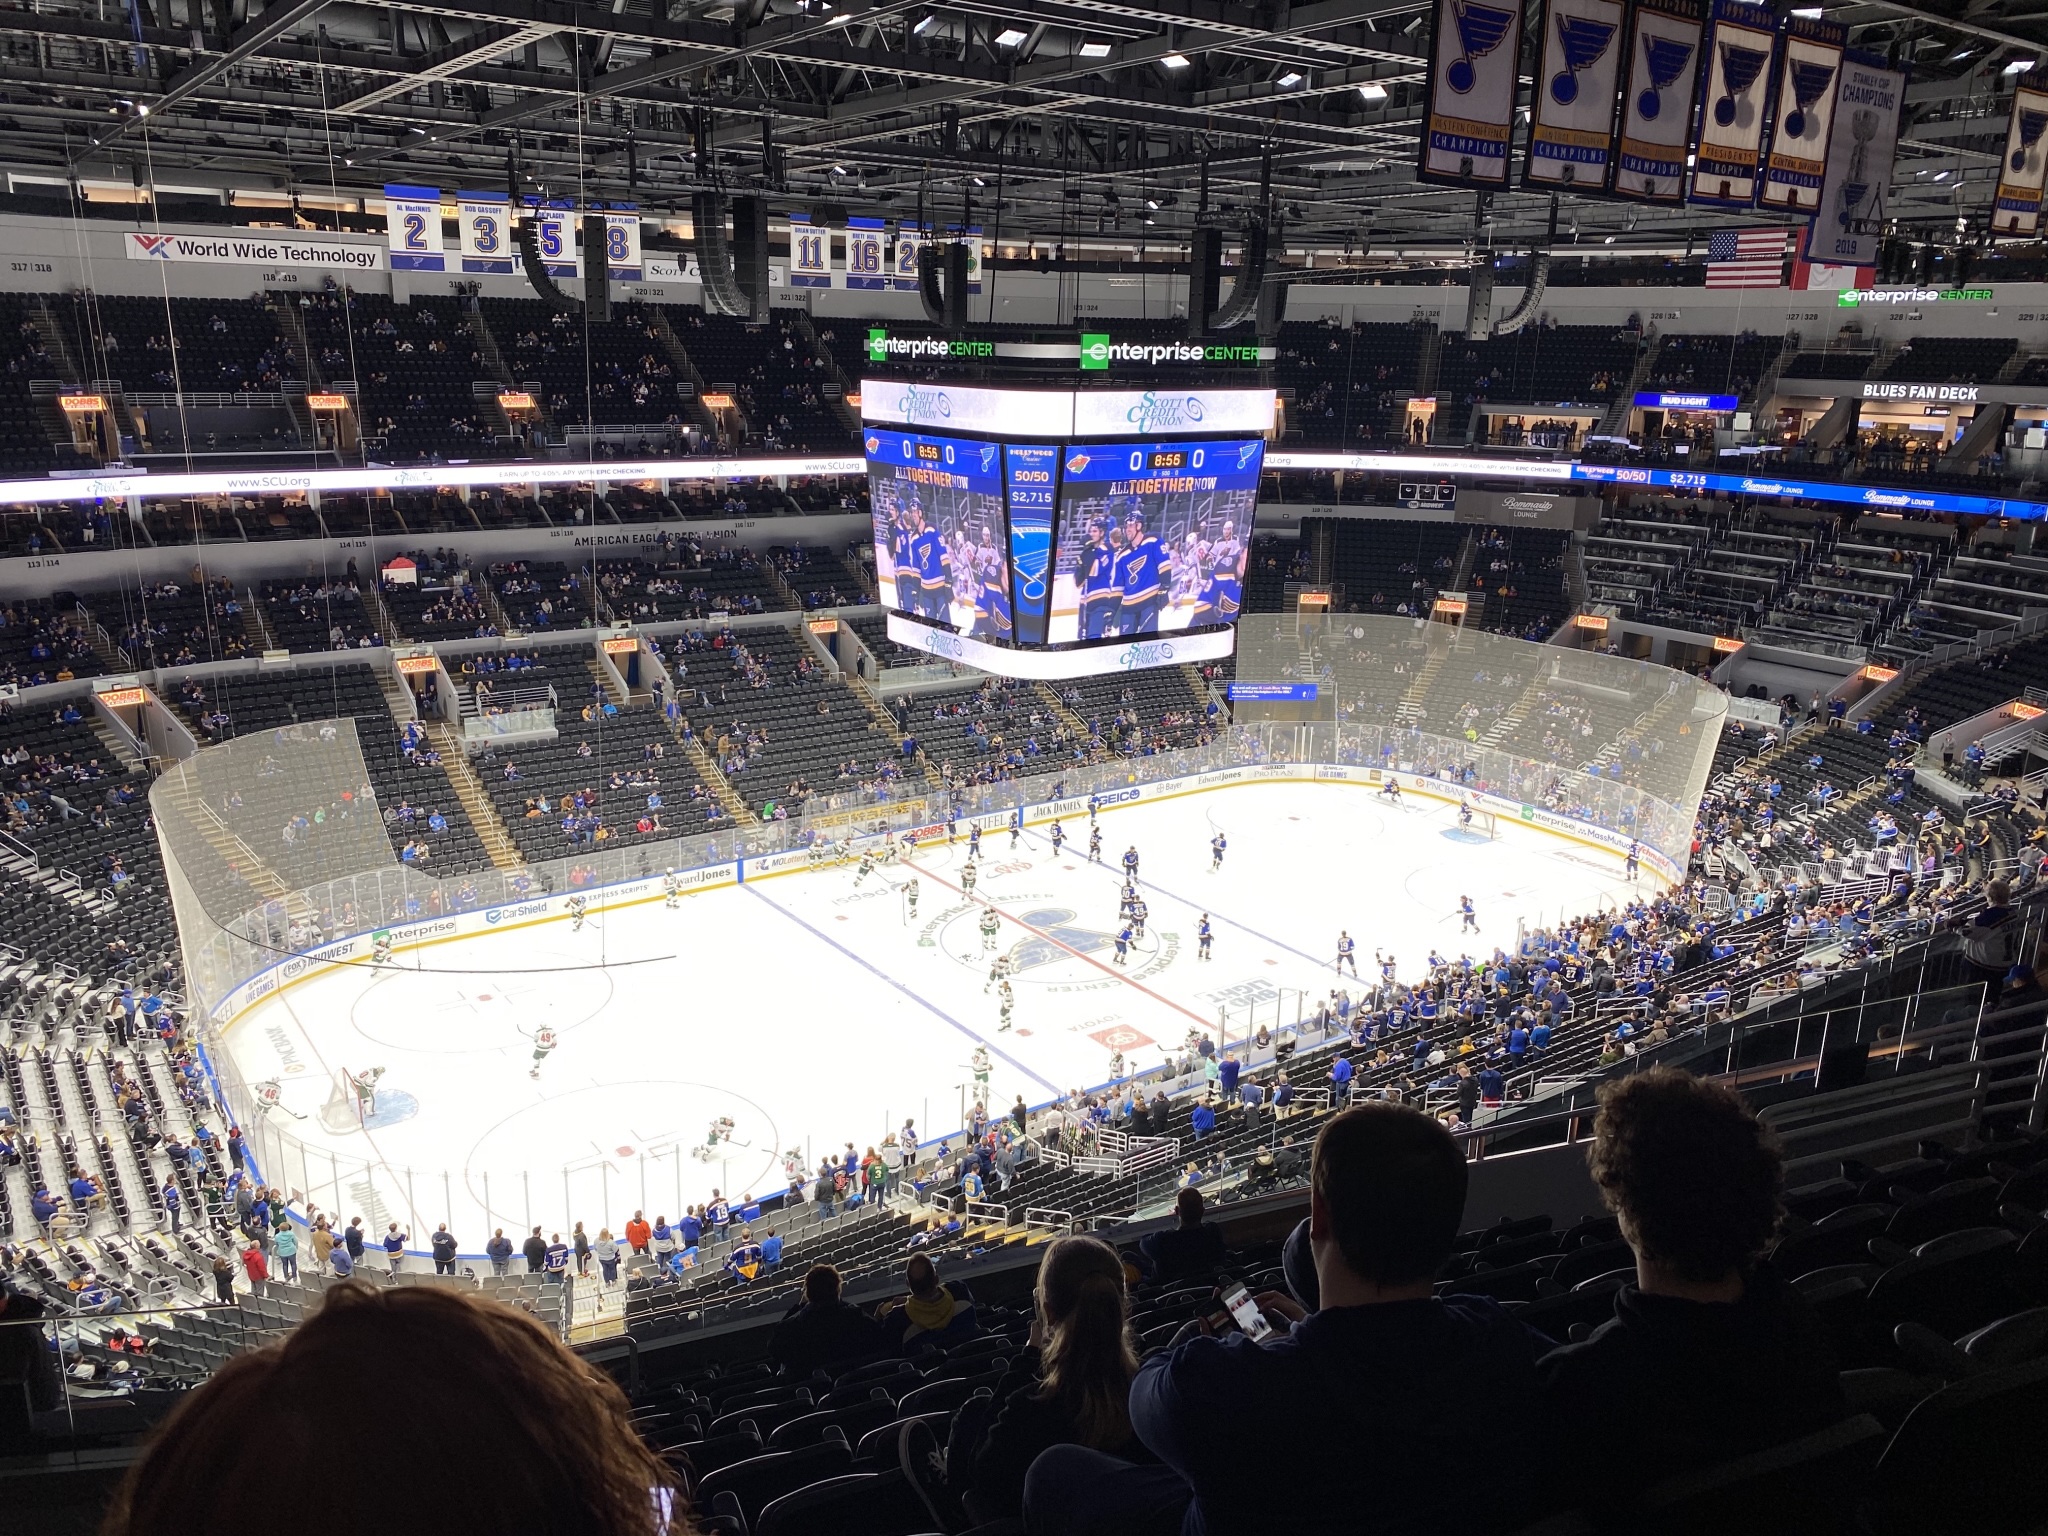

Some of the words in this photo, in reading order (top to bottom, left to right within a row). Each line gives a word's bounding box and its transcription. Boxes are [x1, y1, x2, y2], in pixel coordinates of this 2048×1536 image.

[1852, 71, 1878, 86] STANLEY
[1878, 76, 1891, 89] CUP
[1842, 84, 1895, 111] CHAMPIONS
[1435, 134, 1504, 156] CHAMPIONS
[1539, 145, 1603, 163] CHAMPIONS
[1625, 156, 1679, 176] CHAMPIONS
[1709, 162, 1744, 177] TROPHY
[464, 205, 475, 213] BOB
[404, 214, 428, 250] 2
[473, 215, 499, 253] 3
[540, 221, 563, 258] 5
[607, 226, 629, 262] 8
[1835, 239, 1857, 255] 2019
[176, 239, 230, 258] World
[233, 242, 278, 260] Wide
[280, 245, 377, 268] Technology
[799, 235, 824, 270] 11
[851, 240, 880, 274] 16
[1838, 287, 1939, 305] enterprise
[1938, 289, 1993, 301] CENTER
[870, 335, 948, 359] enterprise
[948, 340, 993, 358] CENTER
[1083, 341, 1204, 366] enterprise
[1204, 345, 1260, 362] CENTER
[501, 395, 529, 404] DOBBS
[907, 384, 938, 402] SCOTT
[1140, 390, 1185, 408] SCOTT
[1863, 383, 1907, 398] BLUES
[1908, 385, 1938, 399] FAN
[1938, 386, 1980, 401] DECK
[64, 397, 99, 406] DOBBS
[311, 395, 343, 405] DOBBS
[898, 396, 934, 413] CREDIT
[1660, 395, 1680, 406] BUD
[1680, 396, 1709, 407] LIGHT
[906, 408, 938, 424] UNION
[1126, 405, 1179, 423] CREDIT
[1138, 416, 1184, 433] UNION
[902, 440, 912, 459] 0
[918, 445, 938, 460] 8:56
[945, 445, 955, 465] 0
[1129, 451, 1143, 471] 0
[1154, 453, 1181, 467] 8:56
[1192, 449, 1205, 468] 0
[612, 467, 646, 475] CHECKING
[804, 460, 860, 472] www.SCU.org
[227, 475, 311, 489] www.SCU.org
[1014, 470, 1050, 482] 50/50
[1616, 469, 1646, 482] 50/50
[1670, 473, 1707, 485] $2,715
[1740, 479, 1783, 494] Bommarito
[1783, 486, 1804, 495] LOUNGE
[1012, 491, 1052, 504] $2,715
[1501, 496, 1553, 510] Bommarito
[1862, 489, 1911, 506] Bommarito
[1911, 498, 1935, 507] LOUNGE
[1513, 511, 1538, 519] LOUNGE
[574, 534, 630, 547] AMERICAN
[27, 560, 42, 569] 113
[45, 559, 60, 567] 114
[1437, 601, 1465, 611] DOBBS
[809, 620, 838, 632] DOBBS
[1579, 615, 1606, 626] DOBBS
[606, 640, 636, 651] DOBBS
[1130, 642, 1160, 656] SCOTT
[399, 658, 435, 670] DOBBS
[1119, 651, 1156, 665] CREDIT
[1127, 657, 1161, 670] UNION
[1867, 666, 1897, 679] DOBBS
[102, 689, 142, 702] DOBBS
[2015, 702, 2046, 715] DOBBS
[1318, 769, 1329, 778] LIVE
[1329, 771, 1348, 779] GAMES
[1165, 780, 1183, 793] Bayer
[1426, 780, 1446, 794] PNC
[1445, 785, 1467, 799] BANK
[1099, 788, 1141, 806] GEICO
[1033, 803, 1053, 818] JACK
[969, 814, 1007, 829] STIFEL
[1522, 809, 1575, 831] enterprise
[701, 867, 731, 882] Jones
[589, 889, 619, 901] EXPRESS
[621, 885, 649, 896] SCRIPTS
[502, 901, 547, 919] CarShield
[1134, 907, 1144, 916] 49
[1340, 941, 1349, 951] 19
[287, 962, 302, 972] FOX
[307, 943, 355, 967] MIDWEST
[1132, 931, 1182, 981] enterprise
[1566, 969, 1576, 979] 27
[256, 979, 274, 997] GAMES
[1046, 980, 1123, 993] CENTER
[1205, 978, 1275, 1003] LIGHT
[1229, 988, 1279, 1008] BUD
[1066, 1013, 1124, 1032] TOYOTA
[540, 1032, 551, 1043] 49
[264, 1088, 277, 1100] 46
[901, 1137, 912, 1149] 75
[784, 1161, 795, 1174] 14
[875, 1169, 882, 1179] 3
[716, 1206, 729, 1220] 19
[551, 1256, 563, 1268] 17
